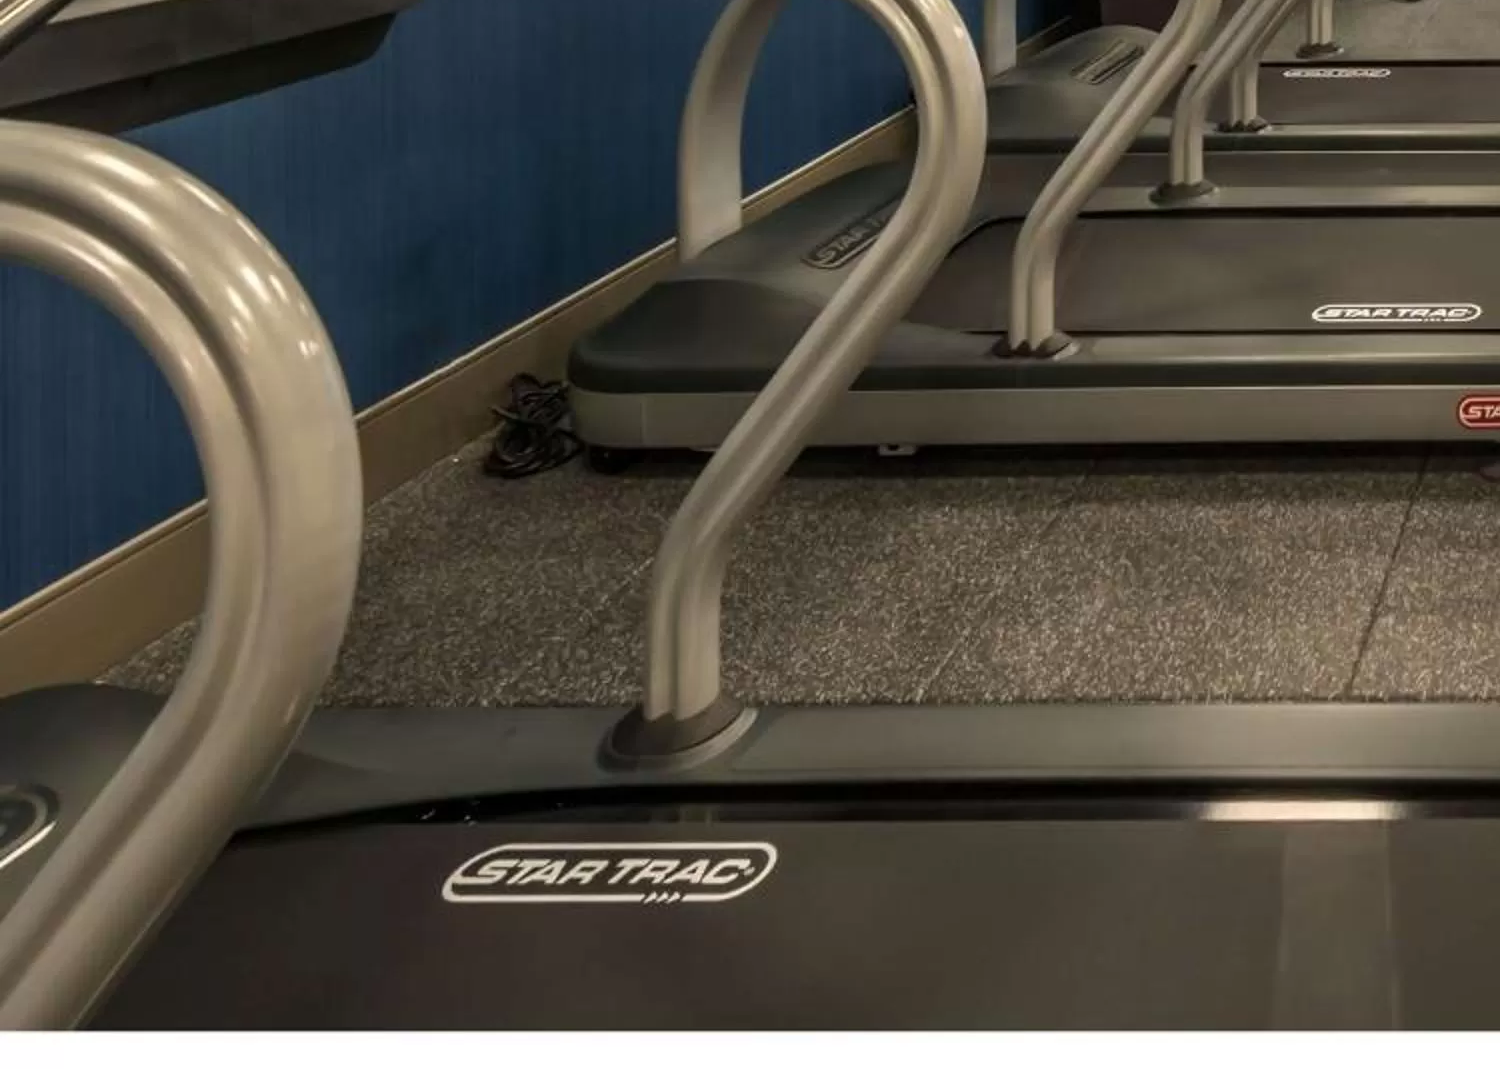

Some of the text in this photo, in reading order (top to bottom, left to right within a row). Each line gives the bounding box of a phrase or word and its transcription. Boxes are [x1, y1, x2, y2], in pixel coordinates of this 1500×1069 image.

[1322, 308, 1469, 318] STAR TRAC
[466, 858, 751, 885] STAR TRAC
